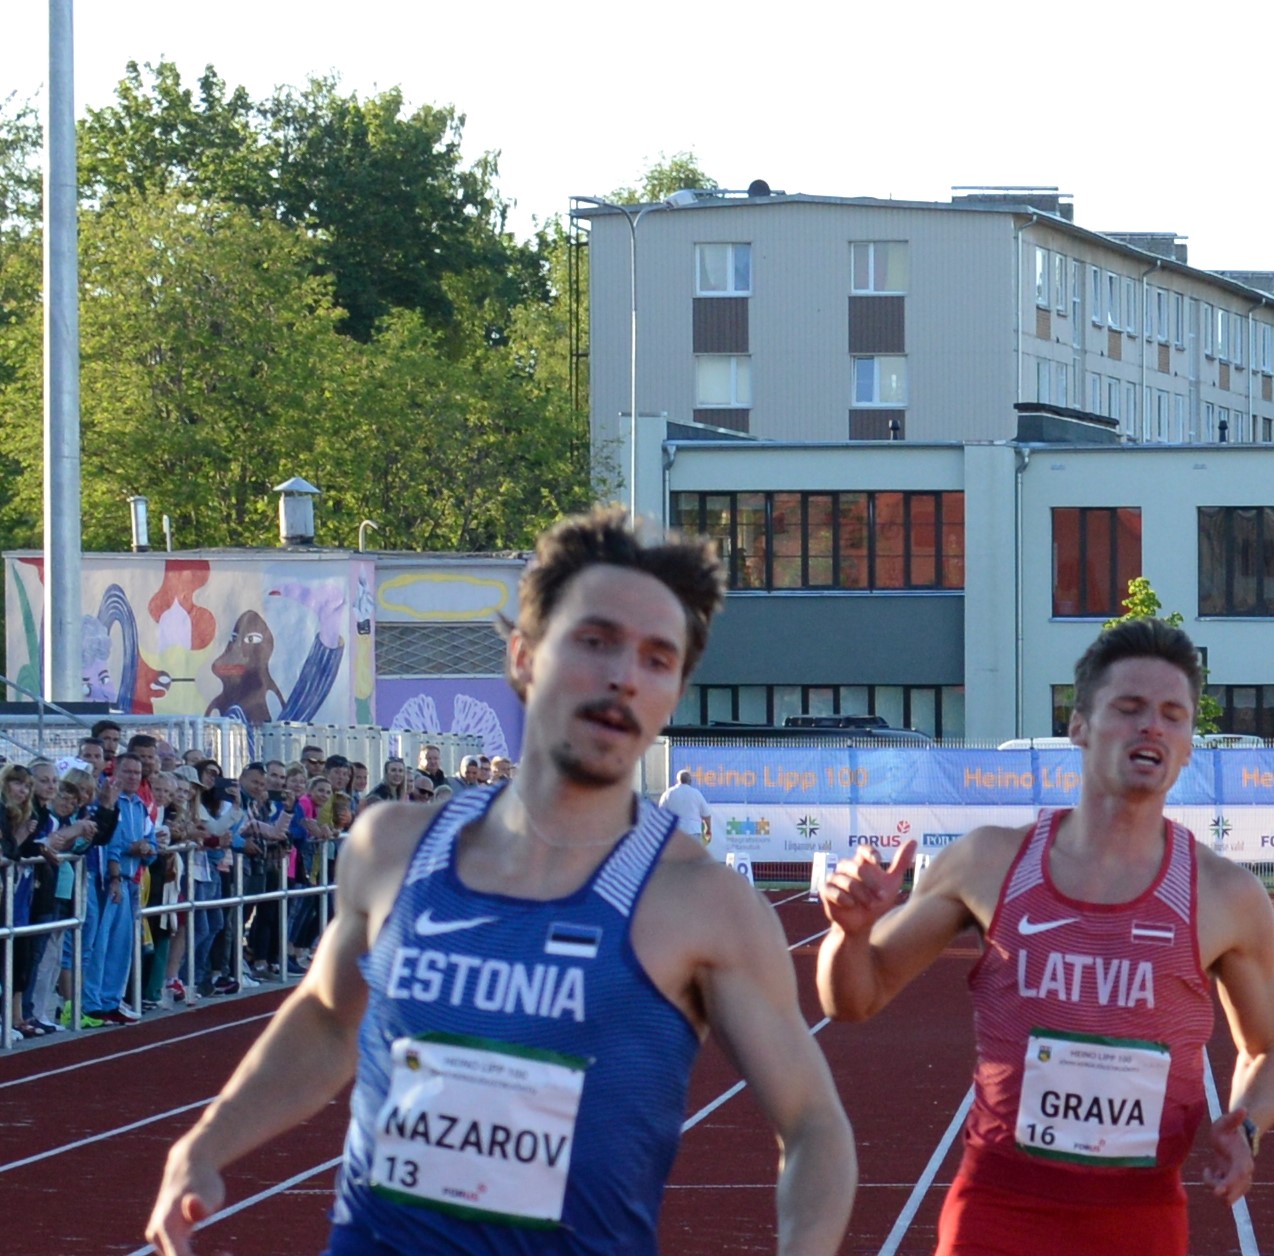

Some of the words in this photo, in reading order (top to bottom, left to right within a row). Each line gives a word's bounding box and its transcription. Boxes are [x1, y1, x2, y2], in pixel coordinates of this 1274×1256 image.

[686, 765, 756, 787] Heino
[763, 765, 818, 791] Lipp
[825, 767, 869, 788] 100
[963, 767, 1035, 789] Heino
[1042, 767, 1082, 792] Lip
[849, 835, 901, 848] FORUS
[387, 947, 585, 1022] ESTONIA
[1017, 949, 1155, 1009] LATVIA
[1070, 1050, 1097, 1060] HEINO
[1098, 1053, 1117, 1062] LIPP
[1118, 1055, 1132, 1064] 100
[1040, 1090, 1145, 1127] GRAVA
[386, 1107, 567, 1168] NAZAROV
[1026, 1123, 1056, 1146] 16
[384, 1156, 420, 1189] 13
